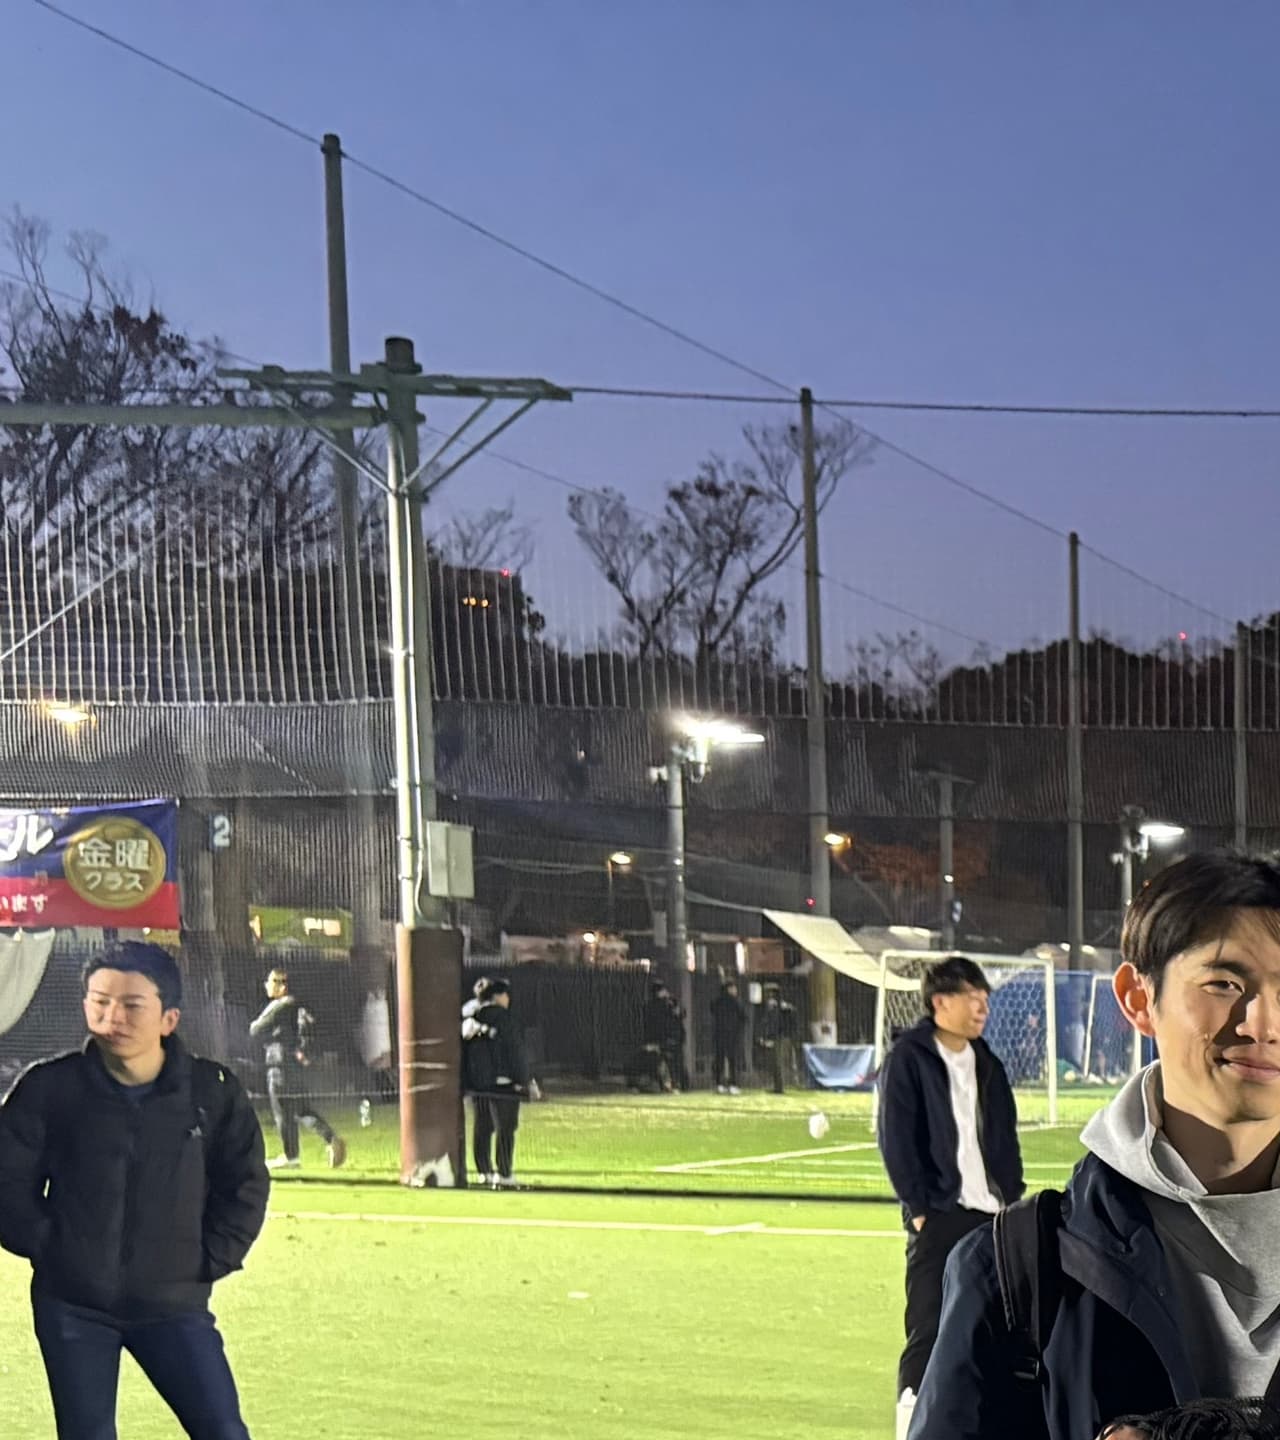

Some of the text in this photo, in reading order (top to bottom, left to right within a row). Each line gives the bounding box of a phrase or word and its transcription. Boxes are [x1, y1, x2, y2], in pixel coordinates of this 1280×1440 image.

[213, 815, 230, 848] 2
[79, 837, 150, 871] 金曜
[86, 871, 144, 892] クラス
